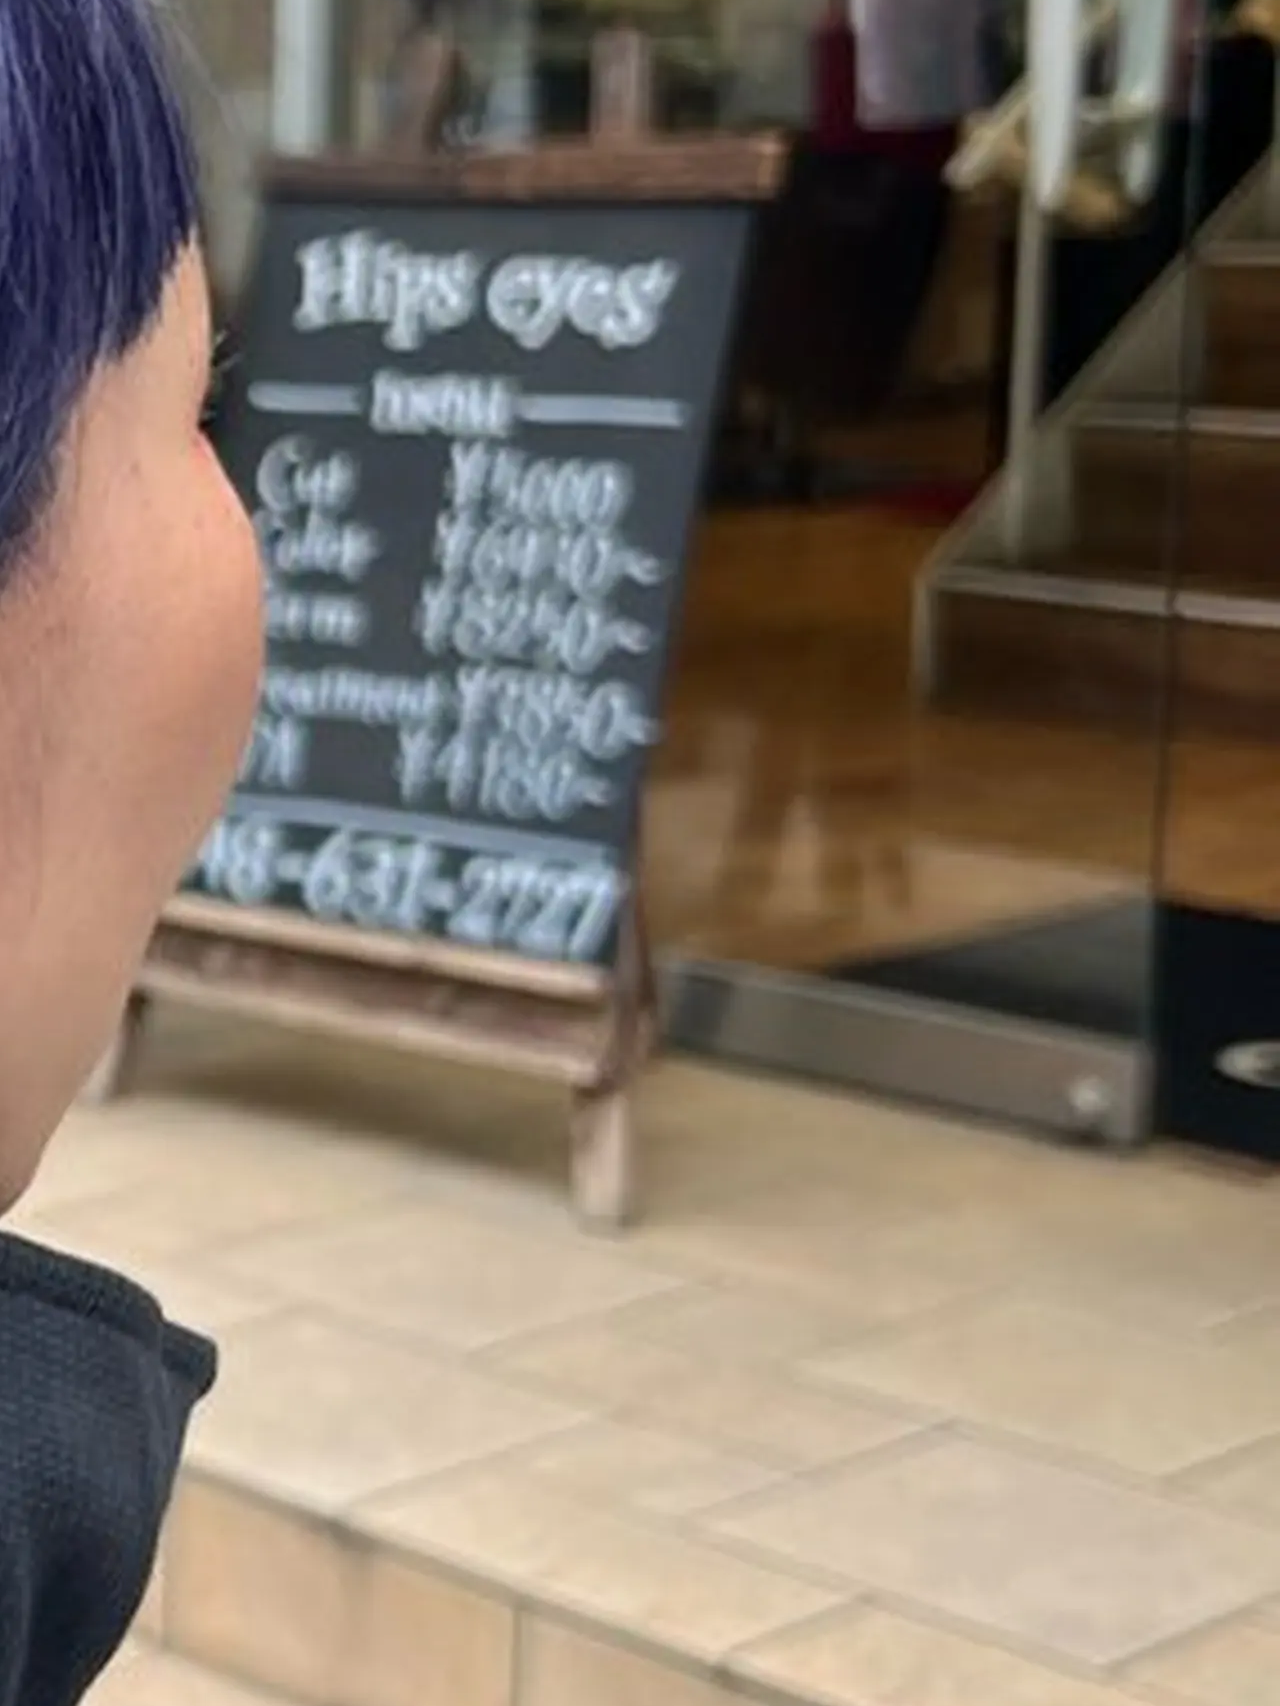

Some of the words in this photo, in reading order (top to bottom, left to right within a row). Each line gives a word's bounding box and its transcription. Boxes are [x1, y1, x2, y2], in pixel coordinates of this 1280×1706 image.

[294, 228, 481, 352] Hips
[485, 252, 678, 351] eyes
[256, 435, 359, 515] Cut
